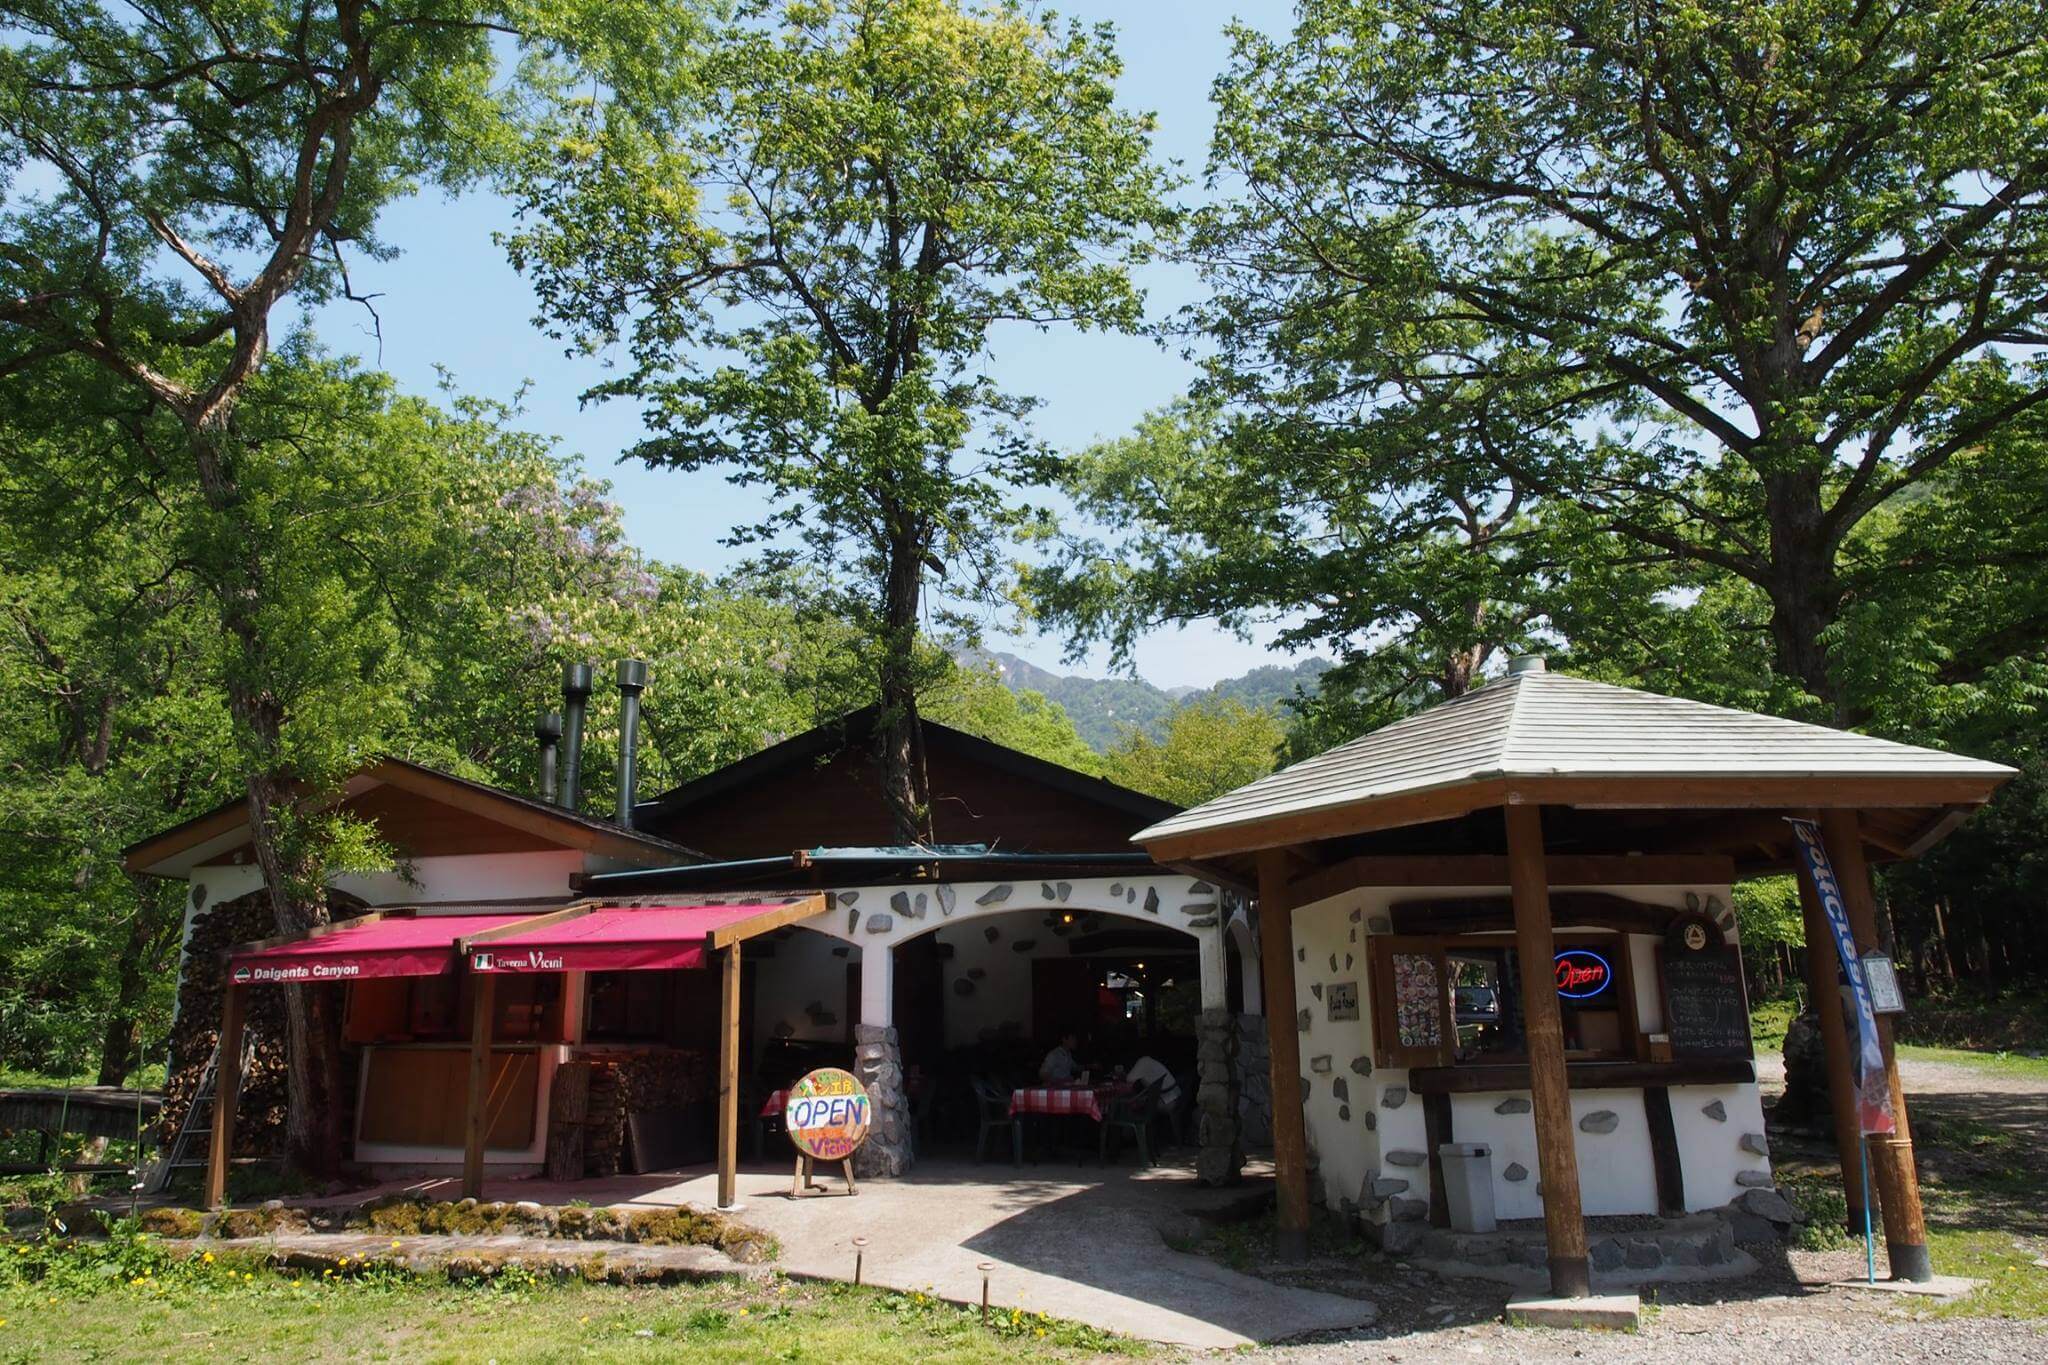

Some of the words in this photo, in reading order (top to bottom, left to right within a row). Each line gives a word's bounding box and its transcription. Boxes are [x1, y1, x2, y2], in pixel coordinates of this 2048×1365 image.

[496, 958, 528, 968] Taverna
[529, 951, 563, 969] Vicini
[254, 966, 310, 981] Daigenta
[313, 964, 360, 978] Canyon
[1554, 957, 1603, 988] Open
[795, 1098, 865, 1126] OPEN
[808, 1137, 853, 1155] Vicini
